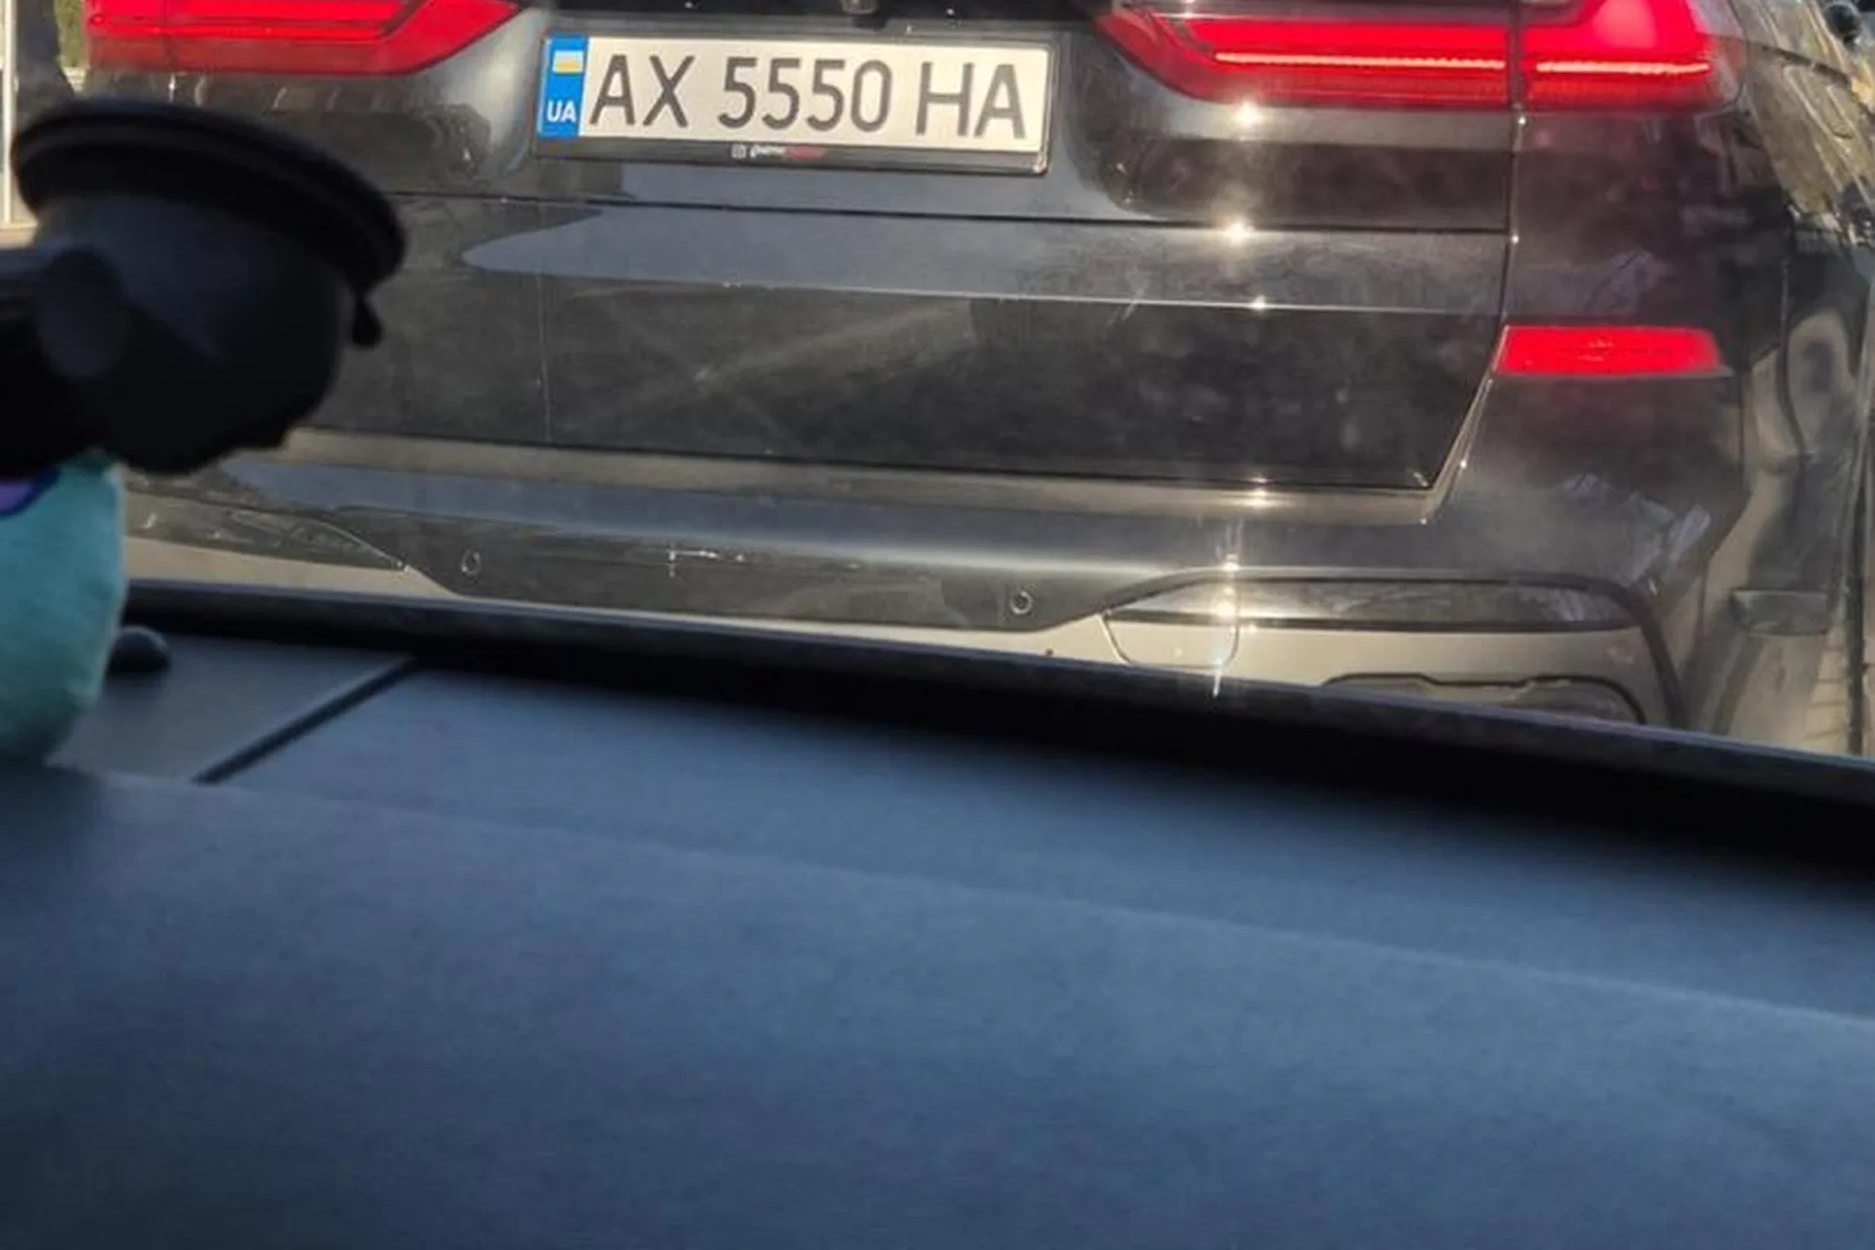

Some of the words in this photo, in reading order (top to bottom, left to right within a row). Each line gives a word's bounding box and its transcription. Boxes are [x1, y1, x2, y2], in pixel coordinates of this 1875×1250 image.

[547, 99, 577, 123] UA
[589, 53, 696, 128] AX
[716, 56, 893, 132] 5550
[915, 62, 1026, 139] HA
